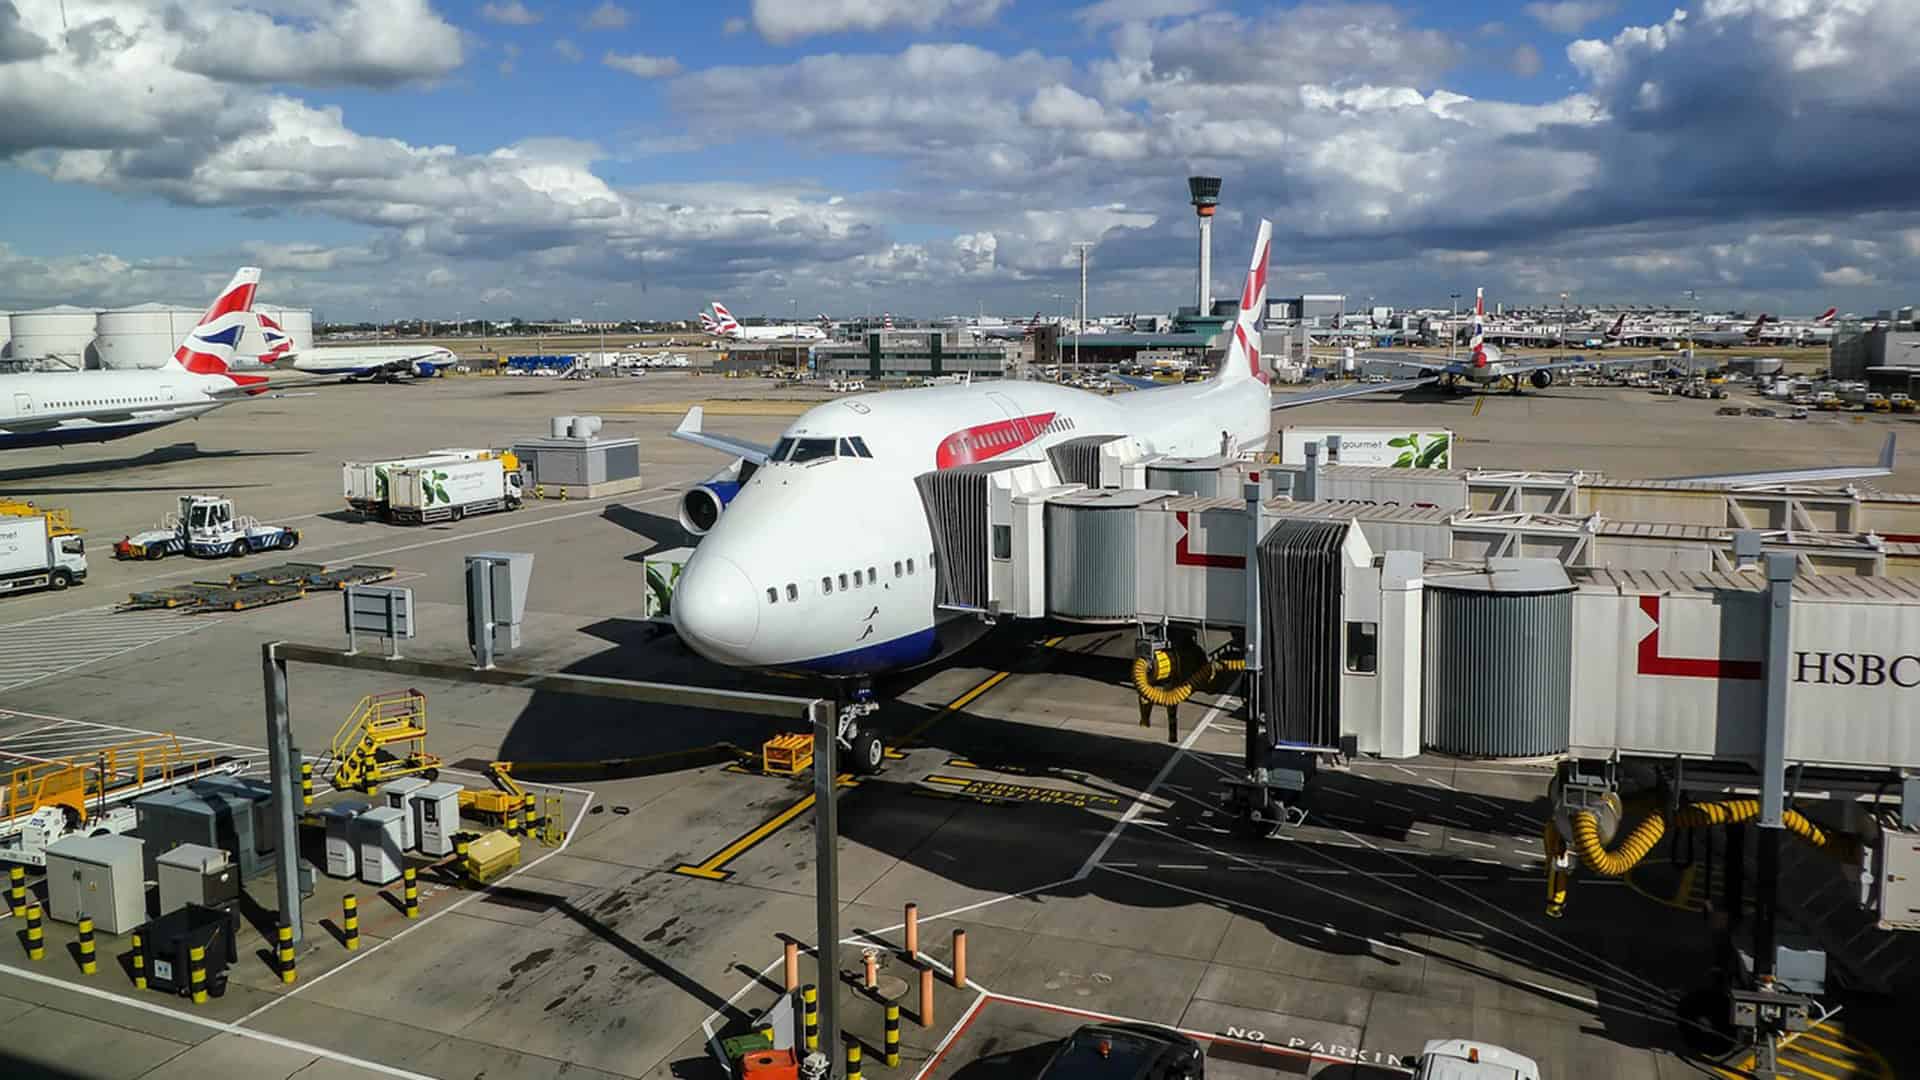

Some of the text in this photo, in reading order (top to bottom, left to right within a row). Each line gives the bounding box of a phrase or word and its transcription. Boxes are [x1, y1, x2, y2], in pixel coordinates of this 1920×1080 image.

[1792, 651, 1920, 688] HSBC
[1227, 1026, 1402, 1067] NO PARKIN
